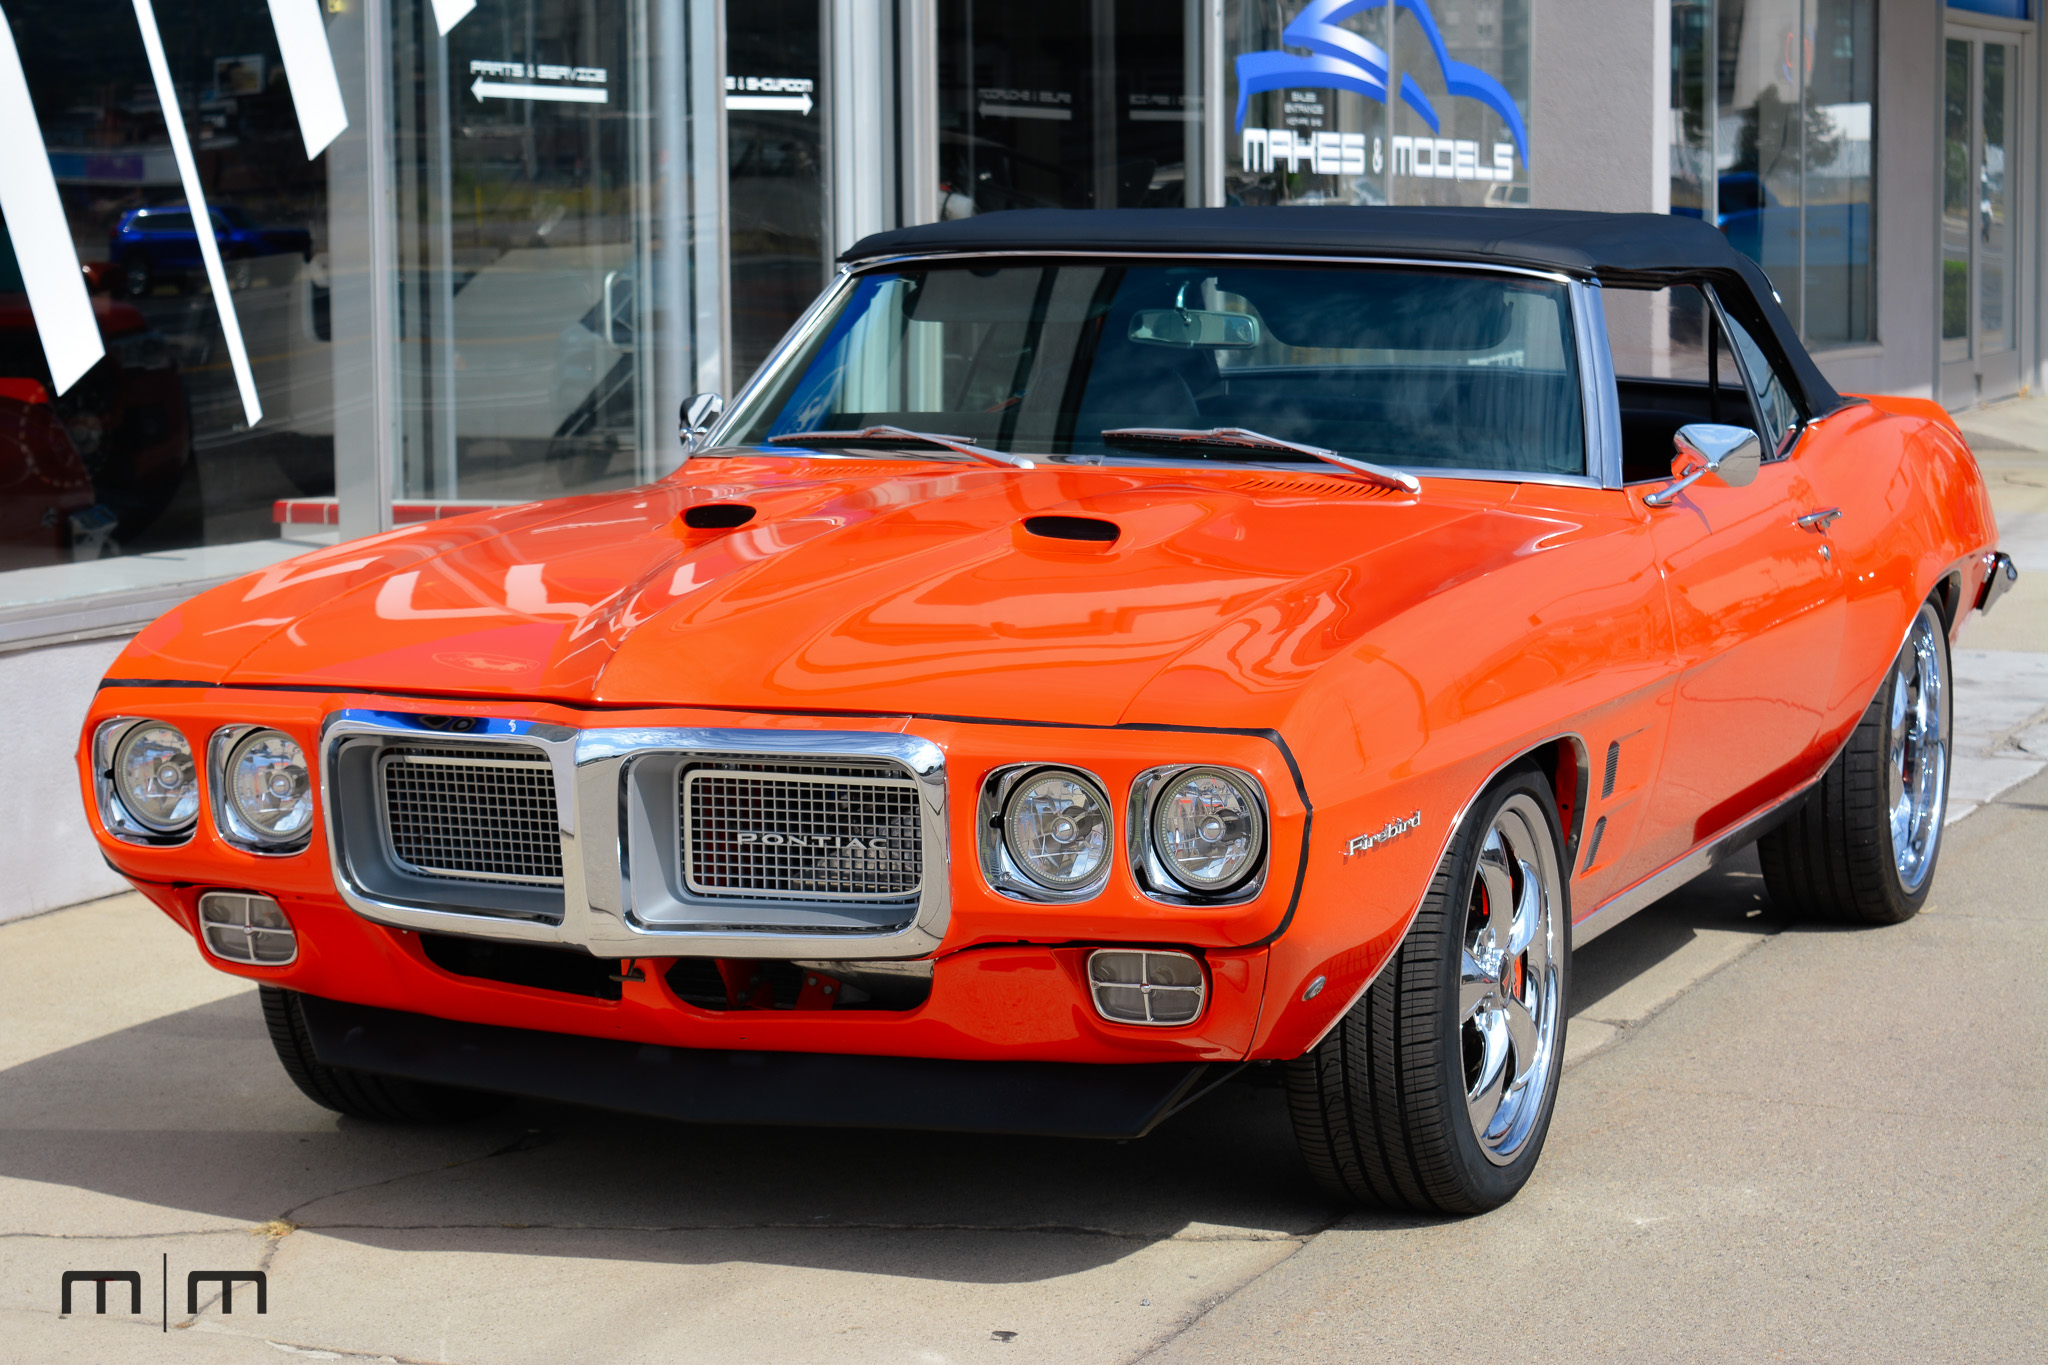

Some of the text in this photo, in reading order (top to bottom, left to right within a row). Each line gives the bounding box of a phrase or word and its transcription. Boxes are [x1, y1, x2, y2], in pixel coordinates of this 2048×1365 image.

[470, 60, 525, 77] PARTS
[537, 64, 607, 82] SERVICE
[1243, 128, 1514, 181] MAKES & MODELS
[737, 832, 888, 850] PONTIAC
[1346, 809, 1421, 857] Firebird
